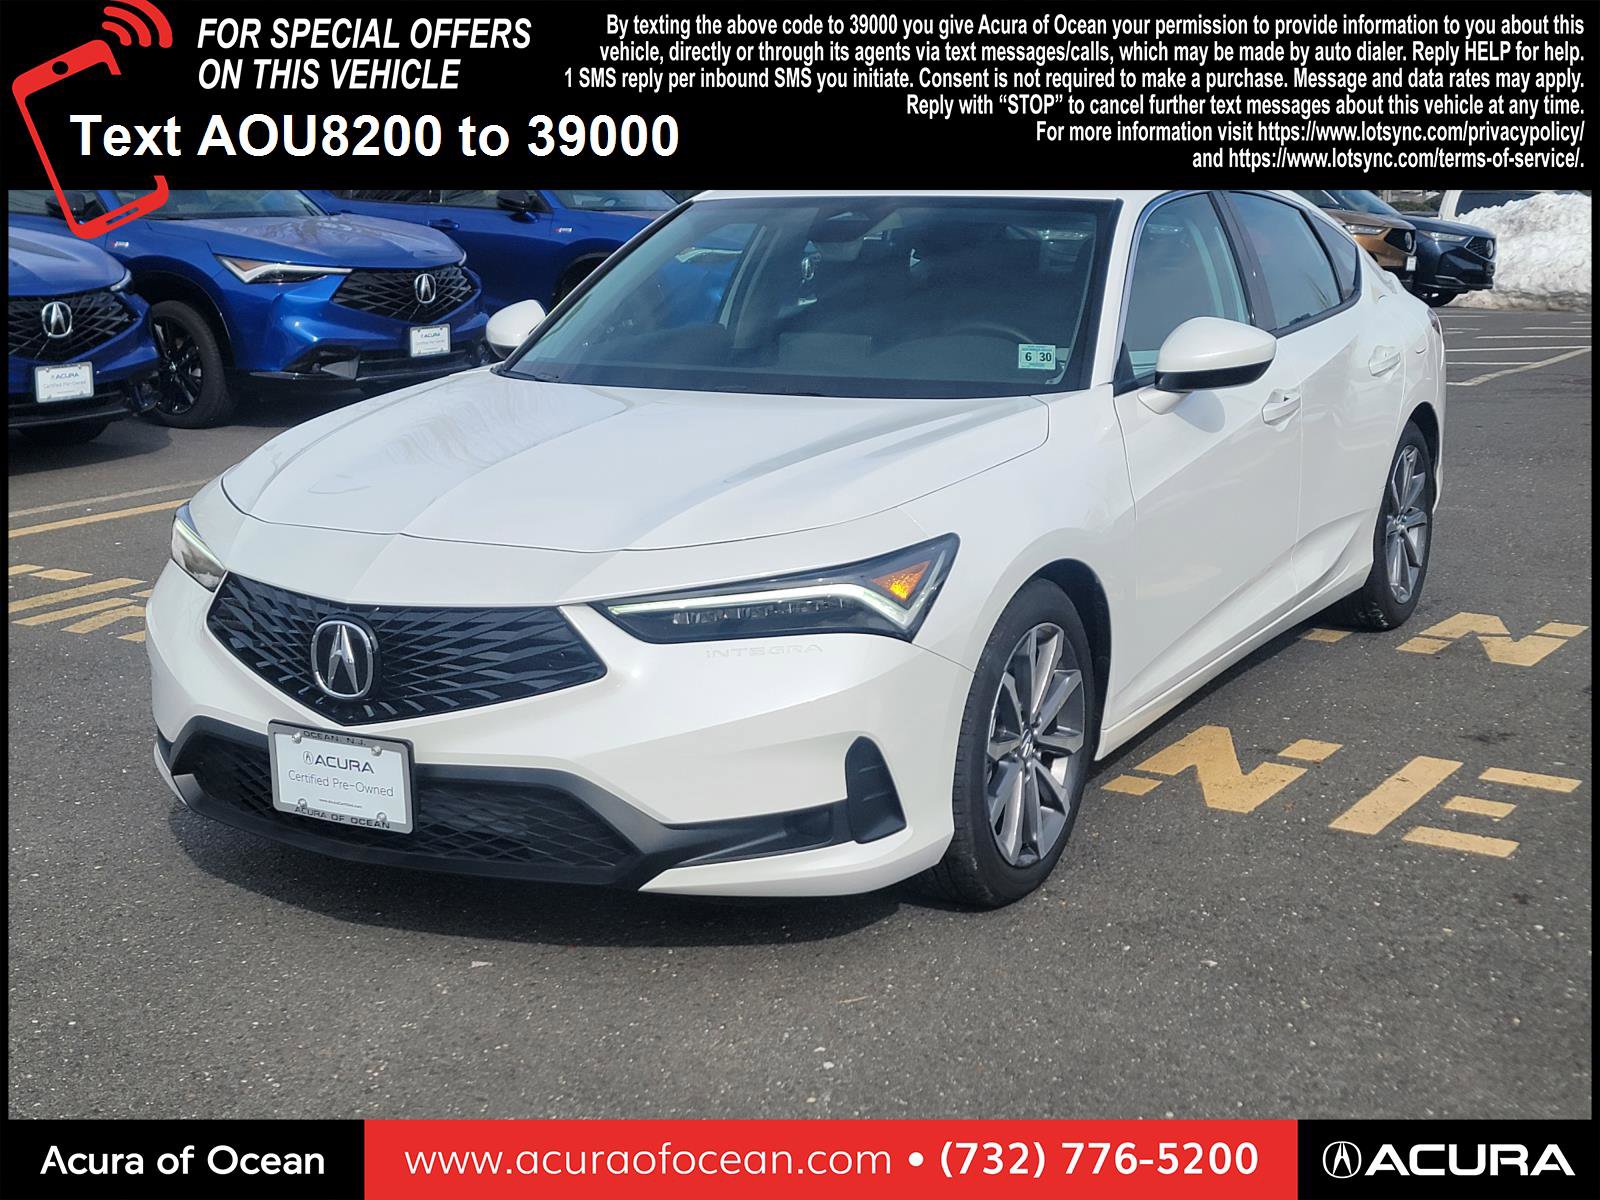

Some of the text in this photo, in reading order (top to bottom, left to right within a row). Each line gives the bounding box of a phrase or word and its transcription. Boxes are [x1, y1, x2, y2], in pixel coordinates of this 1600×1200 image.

[1025, 352, 1052, 361] 6 30
[706, 644, 824, 659] INTEGRA
[314, 754, 375, 774] ACURA
[288, 769, 394, 797] Certified Pre-Owned
[294, 806, 390, 829] ACURA OF OCEAN
